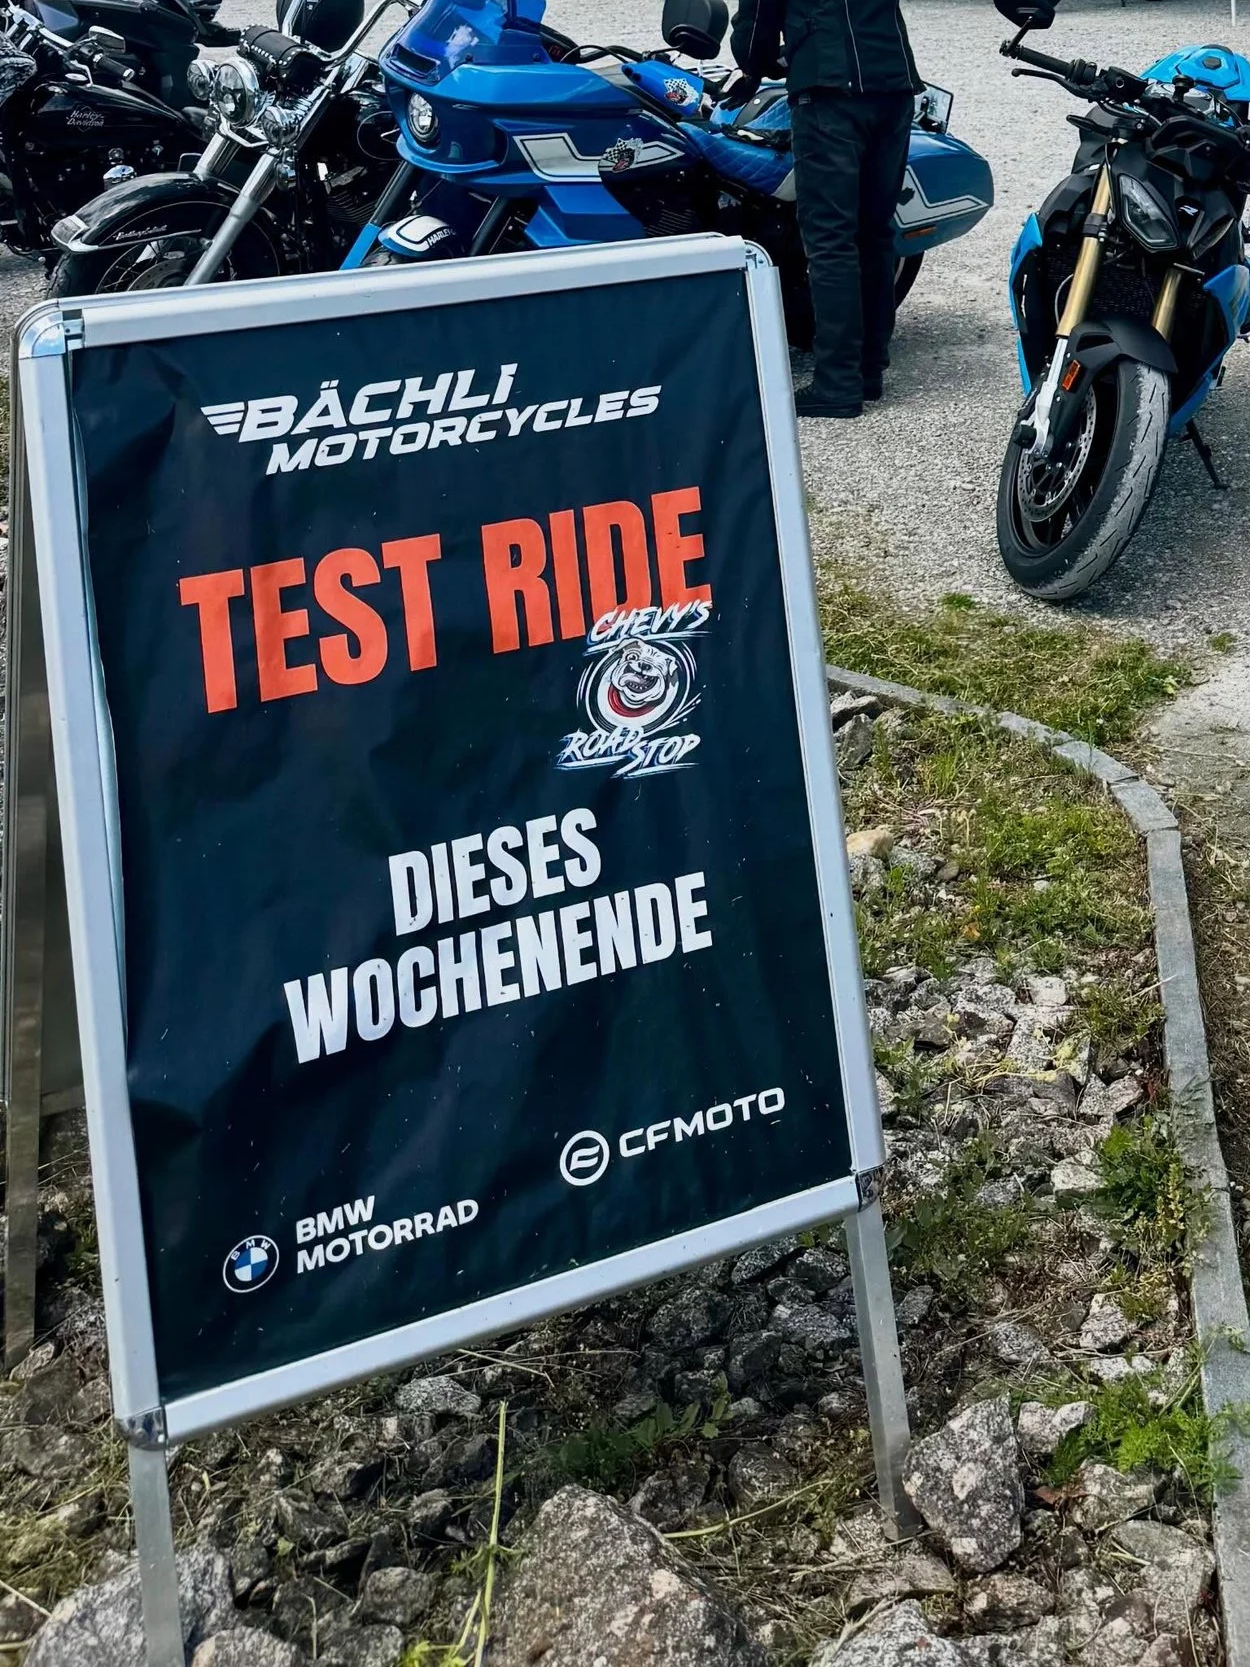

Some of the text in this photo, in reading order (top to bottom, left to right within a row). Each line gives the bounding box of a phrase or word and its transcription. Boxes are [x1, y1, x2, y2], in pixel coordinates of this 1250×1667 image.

[238, 363, 518, 443] BÄCHLI
[265, 384, 663, 476] MOTORCYCLES
[178, 487, 713, 714] TEST RIDE
[588, 600, 713, 642] CHEVY'S
[612, 733, 701, 778] STOP
[388, 808, 601, 936] DIESES
[283, 871, 713, 1064] WOCHENENDE
[619, 1086, 786, 1158] CFMOTO
[230, 1237, 271, 1262] BMW
[296, 1195, 375, 1244] BMW
[297, 1198, 479, 1274] MOTORRAD
